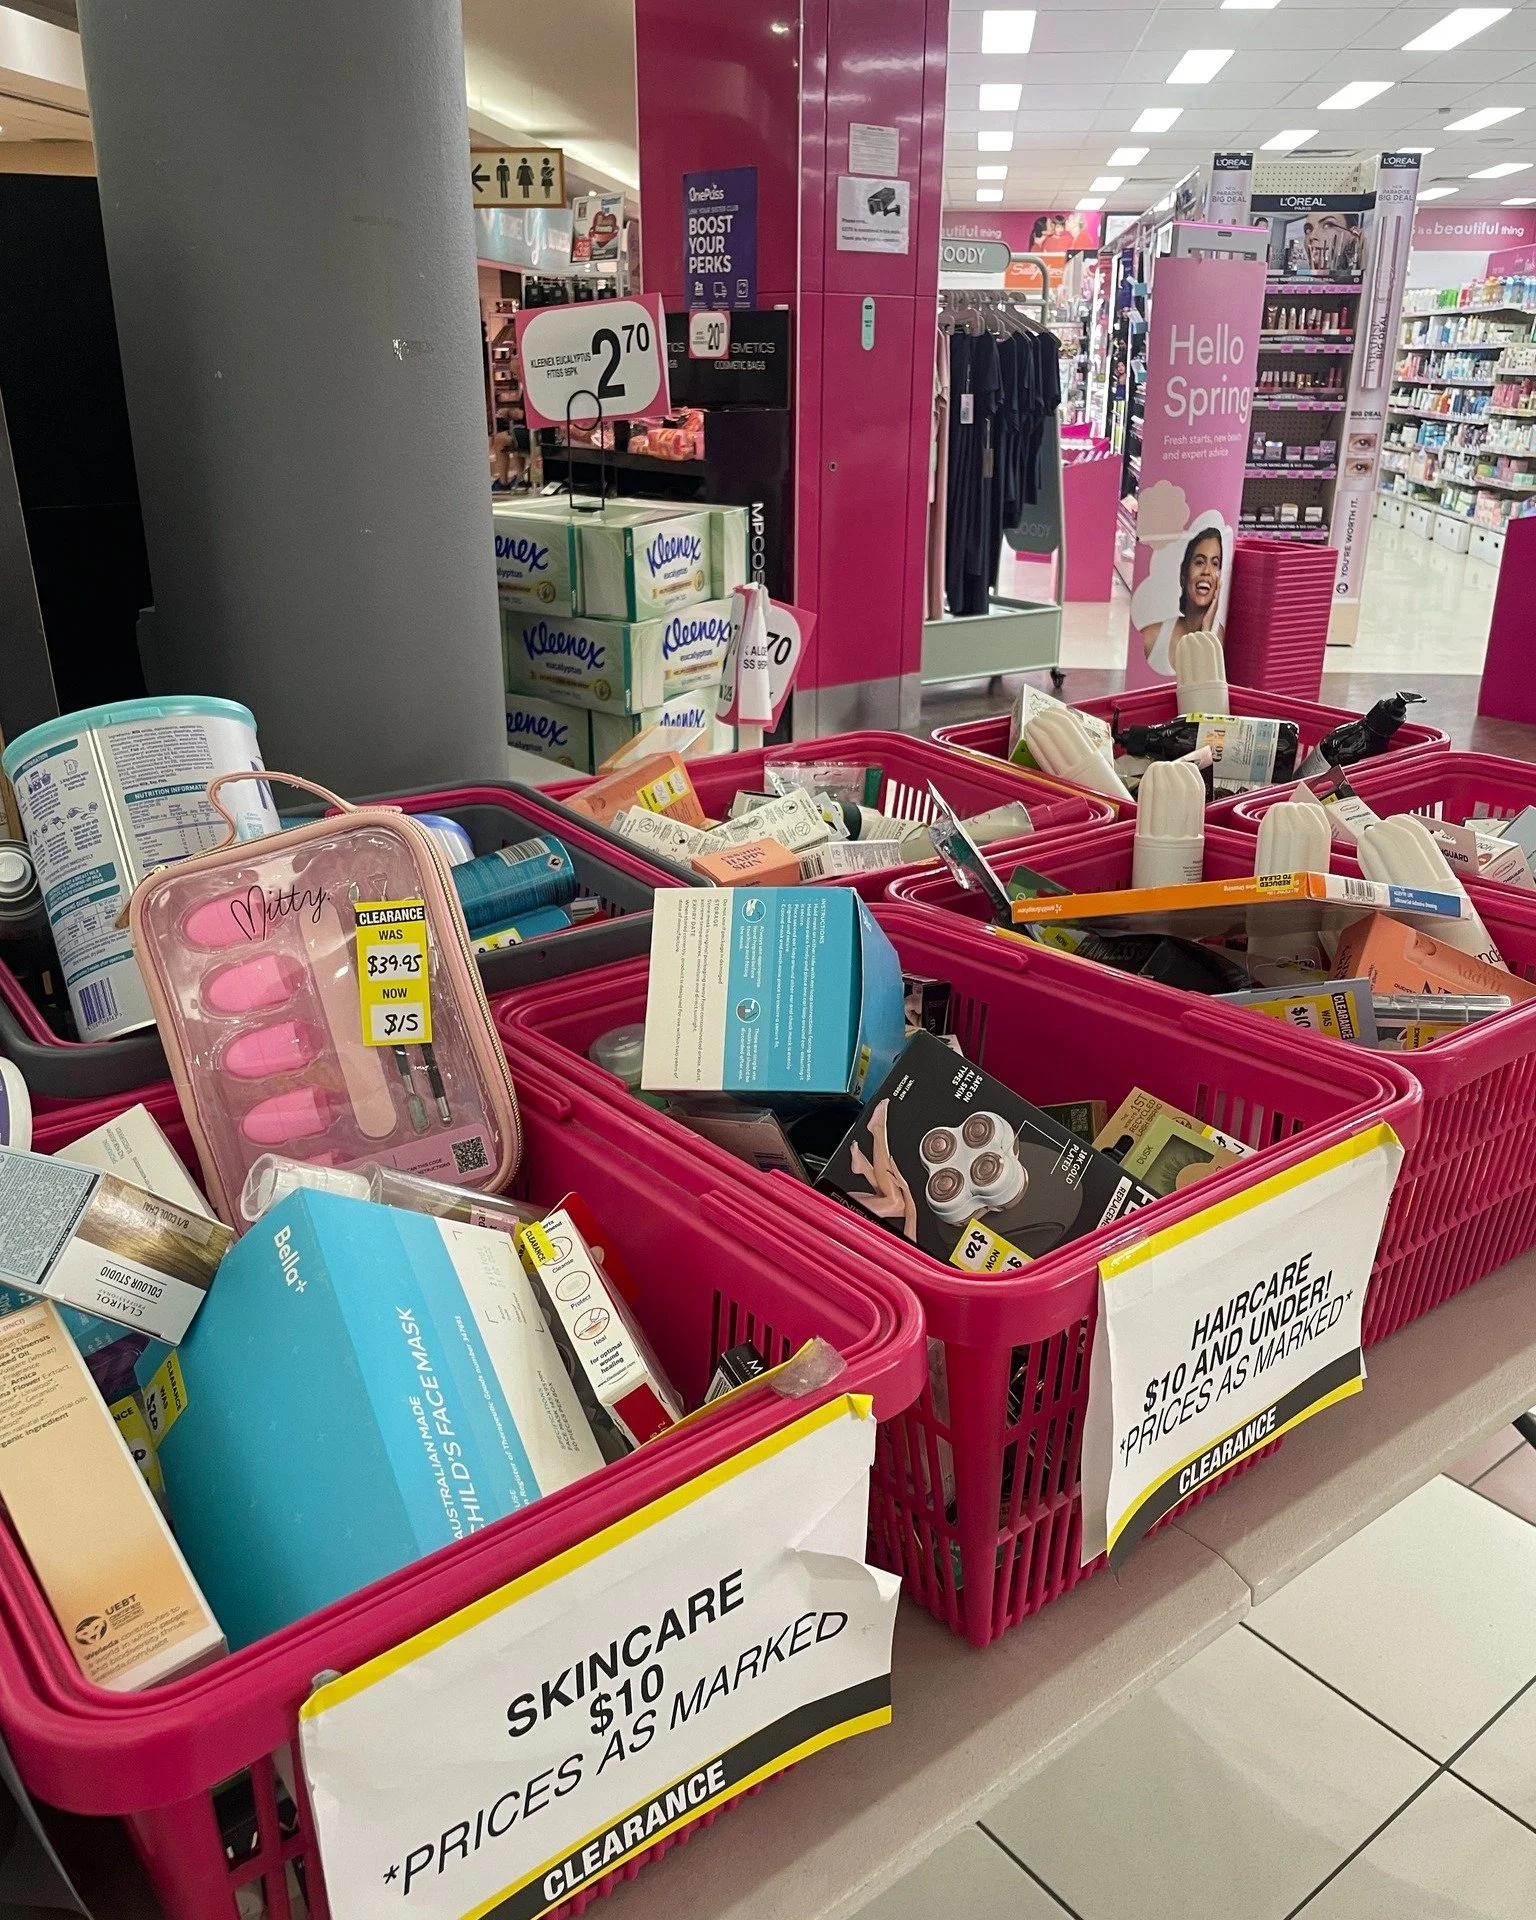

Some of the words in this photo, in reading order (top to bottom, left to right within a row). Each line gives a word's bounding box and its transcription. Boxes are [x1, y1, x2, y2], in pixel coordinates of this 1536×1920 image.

[1212, 195, 1225, 203] BIG
[1227, 195, 1247, 203] DEAL
[688, 215, 733, 235] BOOST
[1434, 222, 1500, 235] beautiful
[1501, 226, 1525, 237] thing
[688, 236, 725, 254] YOUR
[940, 247, 986, 264] OODY
[688, 255, 732, 273] PERKS
[1170, 323, 1244, 366] Hello
[530, 354, 555, 369] KLEENEX
[555, 352, 591, 367] EUCALYPTUS
[591, 328, 626, 400] 2
[622, 322, 650, 354] 70
[714, 361, 747, 370] COSMETIC
[748, 361, 765, 370] BAGS
[1164, 374, 1250, 426] Spring
[1164, 435, 1187, 445] Fresh
[1189, 434, 1213, 445] starts,
[1163, 450, 1179, 460] and
[1182, 449, 1208, 461] expert
[1345, 510, 1356, 544] WORTH
[646, 533, 701, 576] Kleenex
[1341, 545, 1350, 577] YOU'RE
[663, 567, 689, 580] eucalyptus
[522, 620, 606, 671] Kleenex
[661, 617, 732, 660] Kleenex
[680, 649, 713, 662] eucalyptus
[545, 662, 583, 675] eucalyptus
[134, 788, 171, 800] NUTRITION
[1259, 879, 1290, 887] REDUCED
[357, 908, 424, 926] CLEARANCE
[378, 929, 403, 942] WAS
[1054, 932, 1069, 947] NOW
[366, 951, 423, 977] $39.95
[382, 987, 408, 1000] NOW
[383, 1012, 419, 1034] $15
[1319, 1009, 1333, 1028] WAS
[1332, 994, 1354, 1040] CLEARANCE
[951, 1065, 969, 1087] TYPES
[963, 1069, 976, 1083] ALL
[971, 1074, 984, 1093] SAFE
[953, 1080, 969, 1100] SKIN
[962, 1090, 974, 1104] ON
[1130, 1093, 1148, 1115] 1ST
[1128, 1099, 1156, 1134] RECYCLED
[1060, 1143, 1080, 1172] PLATED
[1075, 1148, 1088, 1165] 18K
[1136, 1145, 1154, 1165] DUSK
[1064, 1163, 1081, 1185] GOLD
[160, 1209, 178, 1224] COOL
[525, 1230, 546, 1263] CLEARANCE
[965, 1230, 989, 1260] $20
[551, 1257, 575, 1275] Cleanse
[984, 1248, 1001, 1272] NOW
[100, 1265, 132, 1286] STUDIO
[130, 1277, 164, 1299] COLOUR
[96, 1293, 144, 1318] CLAIROL
[570, 1294, 592, 1310] Protect
[1191, 1251, 1314, 1351] HAIRCARE
[10, 1334, 51, 1355] Chinensis
[395, 1304, 434, 1372] MASK
[592, 1335, 608, 1347] Heal
[1143, 1359, 1190, 1414] $10
[1190, 1327, 1244, 1388] AND
[1249, 1269, 1333, 1346] UNDER!
[464, 1342, 481, 1374] number
[589, 1356, 600, 1366] for
[599, 1340, 623, 1361] optimal
[598, 1350, 620, 1367] wound
[600, 1356, 625, 1375] healing
[10, 1370, 37, 1386] Arnica
[13, 1376, 41, 1393] Flower
[165, 1360, 182, 1411] CLEARANCE
[476, 1373, 491, 1400] Goods
[1215, 1359, 1250, 1404] AS
[159, 1384, 169, 1410] WAS
[419, 1374, 455, 1437] FACE
[25, 1411, 70, 1437] ingredient
[408, 1395, 434, 1440] MADE
[486, 1400, 510, 1450] Therapeutic
[503, 1450, 514, 1461] of
[1178, 1406, 1278, 1495] CLEARANCE
[423, 1441, 464, 1540] AUSTRALIAN
[508, 1461, 528, 1498] Register
[105, 1593, 137, 1616] UEBT
[83, 1639, 119, 1661] Weleda
[506, 1568, 745, 1738] SKINCARE
[590, 1663, 666, 1737] $10
[597, 1709, 656, 1776] AS
[669, 1610, 849, 1731] MARKED
[542, 1759, 726, 1901] CLEARANCE
